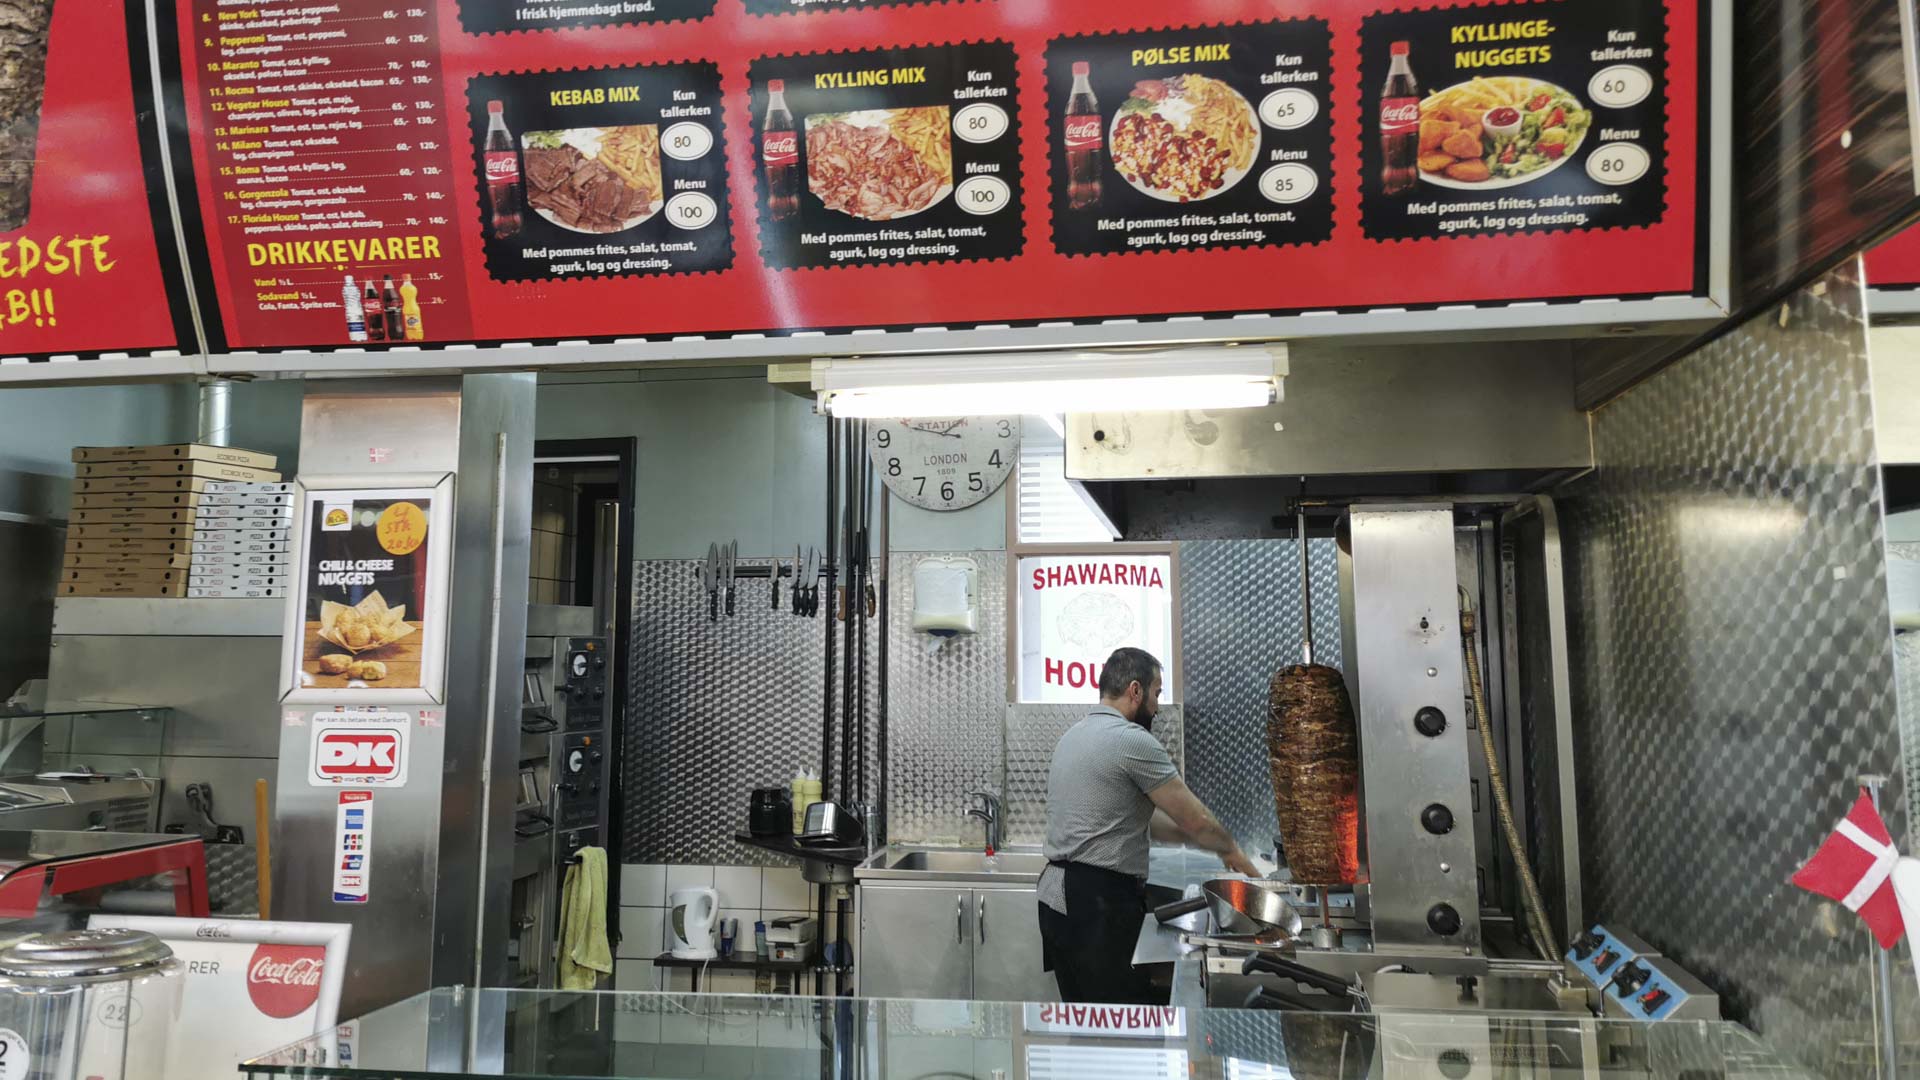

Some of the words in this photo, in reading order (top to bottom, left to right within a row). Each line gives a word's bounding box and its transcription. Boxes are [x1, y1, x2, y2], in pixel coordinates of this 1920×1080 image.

[218, 12, 237, 20] New
[239, 9, 258, 18] York
[522, 8, 547, 19] frisk
[550, 4, 621, 20] hjemmebagt
[624, 1, 654, 12] brød.
[1451, 20, 1555, 44] KYLLINGE-
[1608, 30, 1636, 42] Kun
[220, 34, 265, 46] Pepperoni
[1132, 46, 1190, 66] PØLSE
[1194, 44, 1230, 61] MIX
[1275, 54, 1302, 66] Kun
[1455, 45, 1552, 68] NUGGETS
[1591, 47, 1653, 61] tallerken
[207, 63, 220, 72] 10.
[815, 70, 888, 89] KYLLING
[892, 67, 926, 84] MIX
[968, 70, 992, 81] Kun
[1261, 71, 1318, 84] tallerken
[210, 88, 224, 96] 11.
[954, 86, 1007, 99] tallerken
[1603, 80, 1625, 93] 60
[550, 88, 605, 106] KEBAB
[608, 86, 640, 102] MIX
[673, 90, 696, 101] Kun
[211, 103, 224, 111] 12.
[661, 105, 711, 118] tallerken
[1277, 104, 1295, 118] 65
[969, 117, 987, 129] 80
[215, 128, 228, 136] 13.
[230, 126, 269, 135] Marinara
[1600, 129, 1640, 141] Menu
[216, 142, 230, 151] 14.
[232, 141, 262, 150] Milano
[674, 136, 691, 148] 80
[1271, 149, 1307, 161] Menu
[220, 167, 234, 176] 15.
[235, 166, 260, 175] Roma
[966, 163, 999, 173] Menu
[1601, 159, 1624, 172] 80
[674, 179, 706, 190] Menu
[1275, 178, 1293, 192] 85
[224, 191, 237, 200] 16.
[239, 188, 289, 200] Gorgonzola
[970, 190, 994, 202] 100
[1408, 202, 1436, 215] Med
[1438, 201, 1496, 216] pommes
[1498, 197, 1536, 210] frites,
[1539, 194, 1575, 208] salat,
[1577, 193, 1622, 206] tomat,
[228, 215, 241, 224] 17.
[243, 213, 272, 223] Florida
[273, 213, 299, 222] House
[678, 206, 702, 218] 100
[1098, 218, 1124, 230] Med
[1126, 218, 1179, 232] pommes
[1181, 214, 1217, 227] frites,
[1219, 212, 1252, 225] salat,
[1254, 211, 1296, 223] tomat,
[1439, 217, 1481, 232] agurk,
[1483, 216, 1505, 230] løg
[1508, 218, 1524, 229] og
[1527, 212, 1589, 226] dressing.
[801, 233, 826, 244] Med
[829, 232, 878, 246] pommes
[879, 230, 913, 242] frites,
[915, 228, 946, 239] salat,
[948, 227, 986, 238] tomat,
[1127, 233, 1166, 247] agurk,
[1169, 232, 1189, 245] løg
[1192, 233, 1207, 244] og
[1210, 229, 1266, 242] dressing.
[247, 236, 441, 266] DRIKKEVARER
[523, 248, 546, 258] Med
[549, 246, 594, 260] pommes
[596, 244, 628, 256] frites,
[630, 243, 658, 254] salat,
[661, 242, 697, 252] tomat,
[830, 246, 866, 259] agurk,
[868, 246, 888, 258] løg
[889, 247, 904, 258] og
[906, 243, 959, 256] dressing.
[550, 261, 584, 273] agurk,
[586, 260, 605, 272] løg
[607, 261, 621, 271] og
[622, 257, 672, 270] dressing.
[254, 278, 276, 286] Vand
[257, 291, 299, 301] Sodavand
[0, 288, 56, 330] B!!
[996, 420, 1011, 438] 3
[877, 429, 891, 448] 9
[924, 453, 967, 465] LONDON
[988, 449, 1002, 468] 4
[888, 458, 901, 476] 8
[913, 476, 926, 496] 7
[968, 472, 982, 491] 5
[940, 482, 954, 500] 6
[319, 560, 345, 571] CHILI
[346, 560, 354, 571] &
[355, 560, 394, 571] CHEESE
[318, 572, 375, 585] NUGGETS
[1033, 563, 1163, 590] SHAWARMA
[1045, 658, 1105, 688] HOU
[320, 738, 396, 770] DK
[250, 956, 324, 986] Coca-Cola
